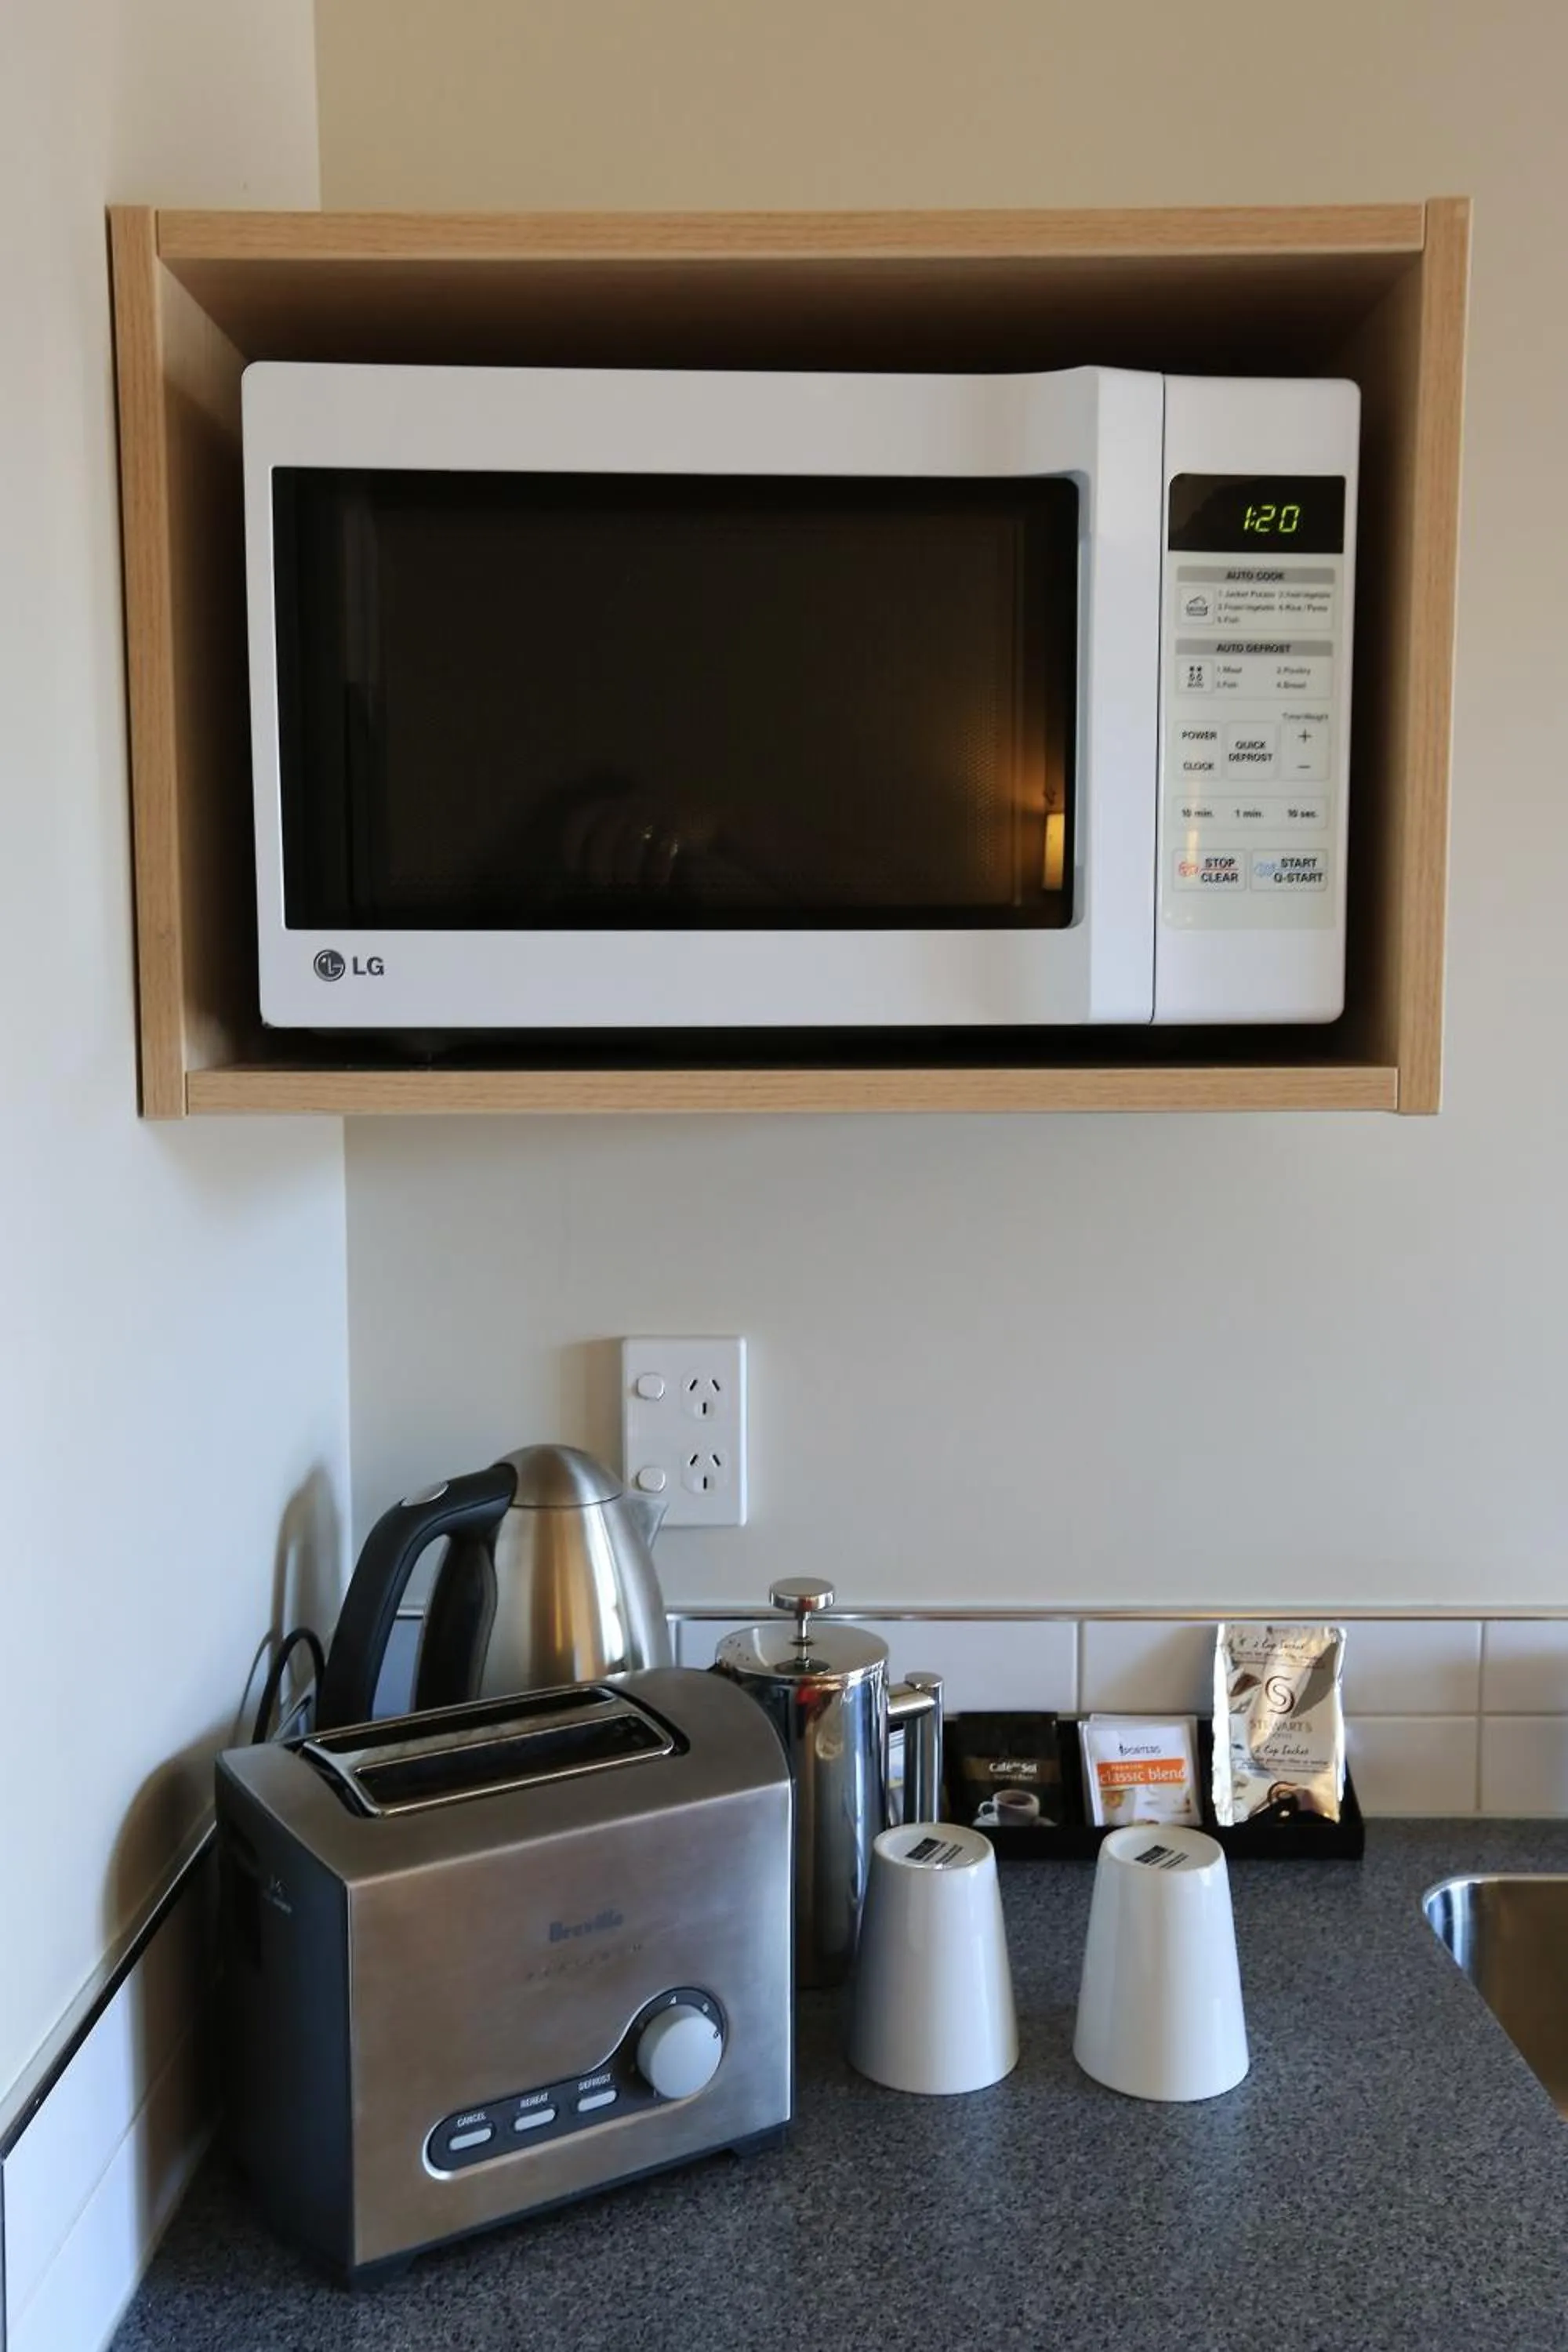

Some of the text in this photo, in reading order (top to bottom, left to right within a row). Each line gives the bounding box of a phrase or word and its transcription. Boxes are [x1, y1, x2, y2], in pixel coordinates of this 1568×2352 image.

[1243, 505, 1301, 533] 1:20
[1226, 571, 1285, 581] AUTO COOK
[1216, 644, 1291, 654] AUTO DEFROST
[1181, 731, 1217, 741] POWER
[1235, 741, 1266, 750] QUICK
[1229, 753, 1273, 762] DEFROST
[1183, 762, 1214, 771] CLOCK
[1205, 858, 1236, 868] STOP
[1280, 858, 1318, 868] START
[1201, 873, 1239, 883] CLEAR
[1273, 873, 1323, 884] Q-START
[352, 956, 384, 976] LG
[1100, 1765, 1186, 1784] classic blend
